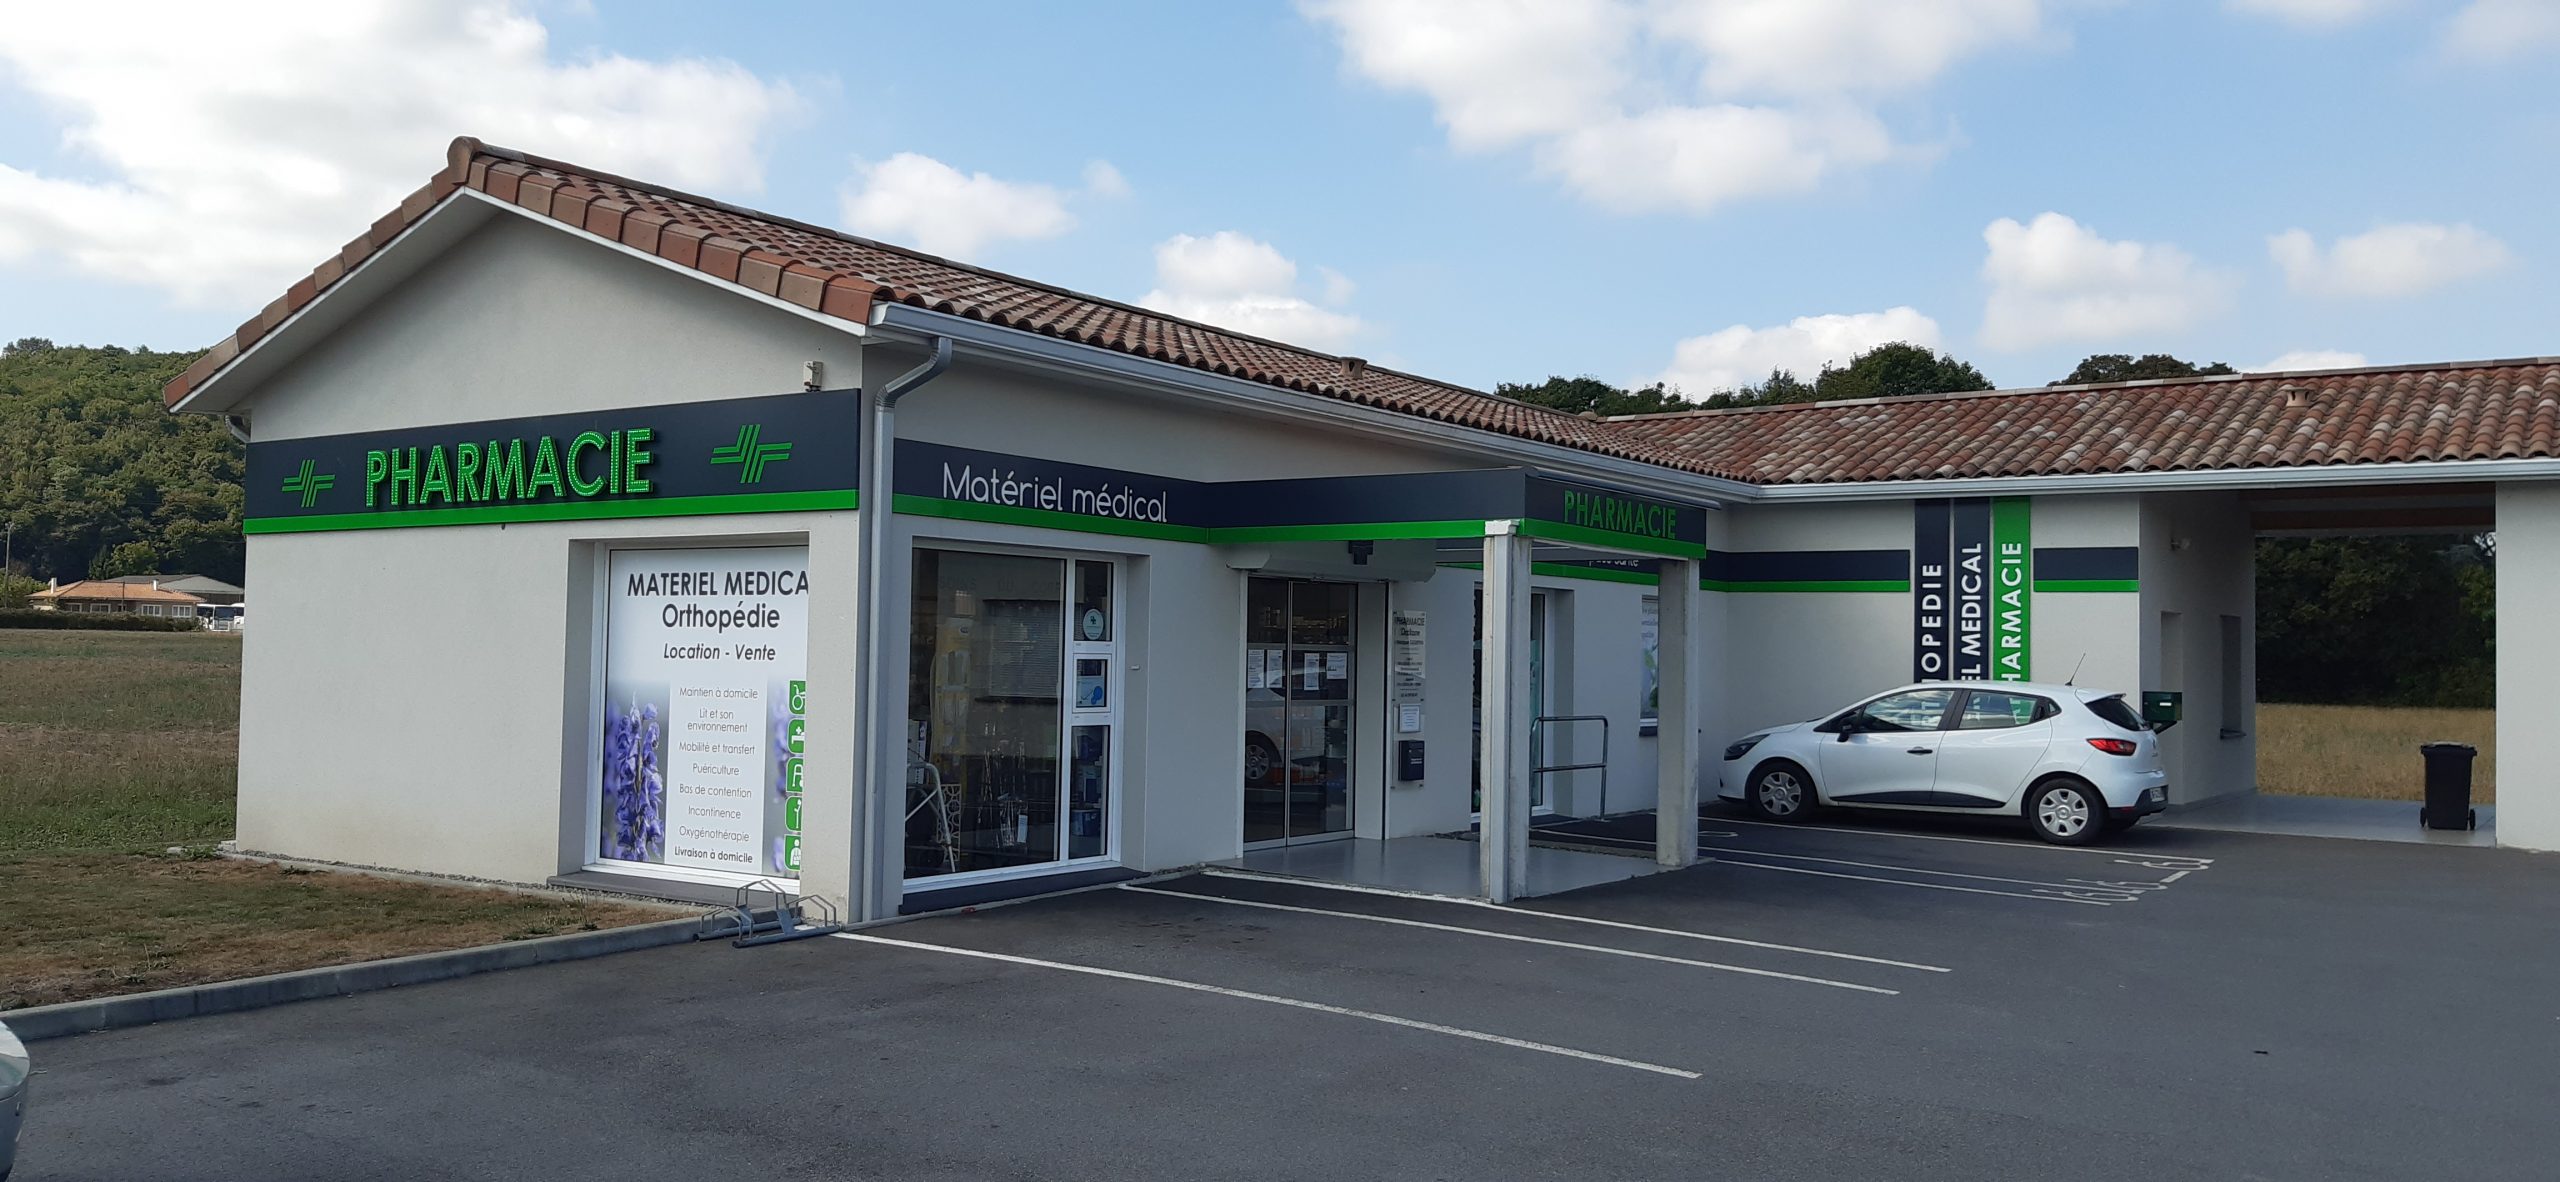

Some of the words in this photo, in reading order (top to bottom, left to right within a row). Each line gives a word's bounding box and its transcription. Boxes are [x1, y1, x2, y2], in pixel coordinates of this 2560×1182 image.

[366, 428, 654, 507] PHARMACIE
[943, 462, 1063, 511] Matériel
[1072, 483, 1167, 523] médical
[1564, 490, 1676, 540] PHARMACIE
[627, 572, 718, 597] MATERIEL
[724, 570, 809, 596] MEDICA
[1961, 543, 1982, 656] MEDICAL
[662, 601, 780, 634] Orthopédie
[663, 643, 720, 660] Location
[735, 644, 776, 661] Vente
[679, 687, 713, 697] Maintien
[715, 687, 721, 698] à
[723, 688, 758, 699] domicile
[699, 707, 708, 718] Lit
[709, 709, 718, 719] et
[720, 711, 733, 719] son
[687, 721, 748, 733] environnement
[679, 741, 710, 752] Mobilité
[712, 744, 720, 753] et
[722, 744, 755, 755] transfert
[692, 763, 740, 776] Puériculture
[679, 783, 693, 794] Bas
[695, 785, 706, 795] de
[707, 787, 752, 798] contention
[688, 805, 741, 819] Incontinence
[679, 825, 750, 843] Oxygénothérapie
[674, 845, 708, 859] Livraison
[709, 848, 716, 860] à
[717, 850, 753, 863] domicile
